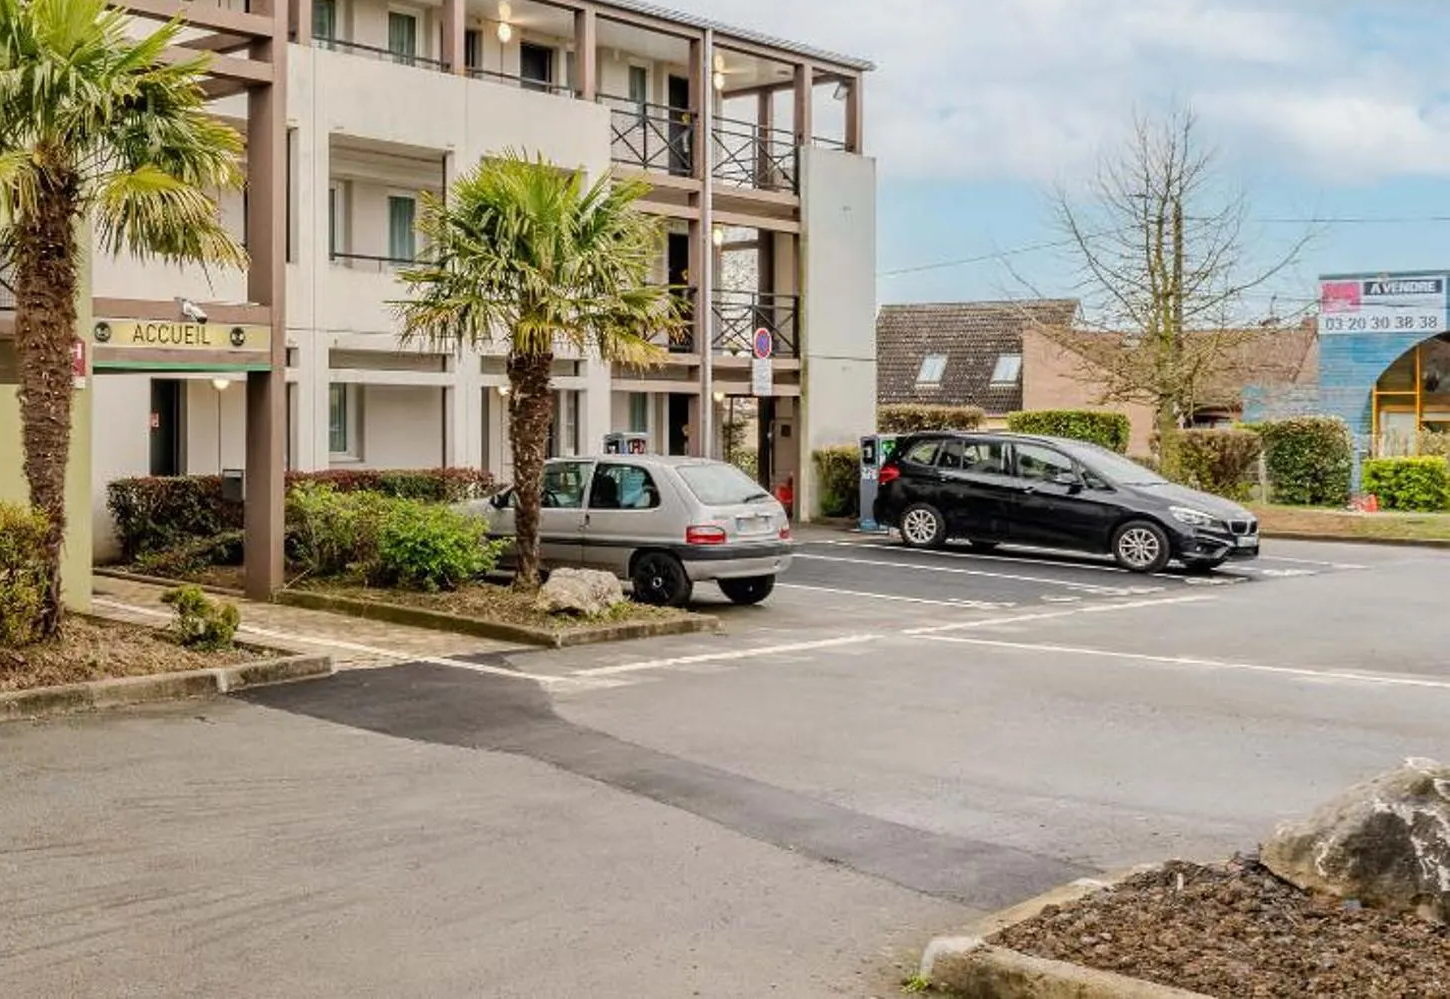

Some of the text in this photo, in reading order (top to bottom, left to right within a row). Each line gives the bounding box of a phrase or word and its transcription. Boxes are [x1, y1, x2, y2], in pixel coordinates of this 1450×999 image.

[1325, 317, 1343, 330] 03
[1349, 317, 1366, 330] 20
[1370, 316, 1389, 330] 30
[133, 323, 211, 345] ACCUEIL
